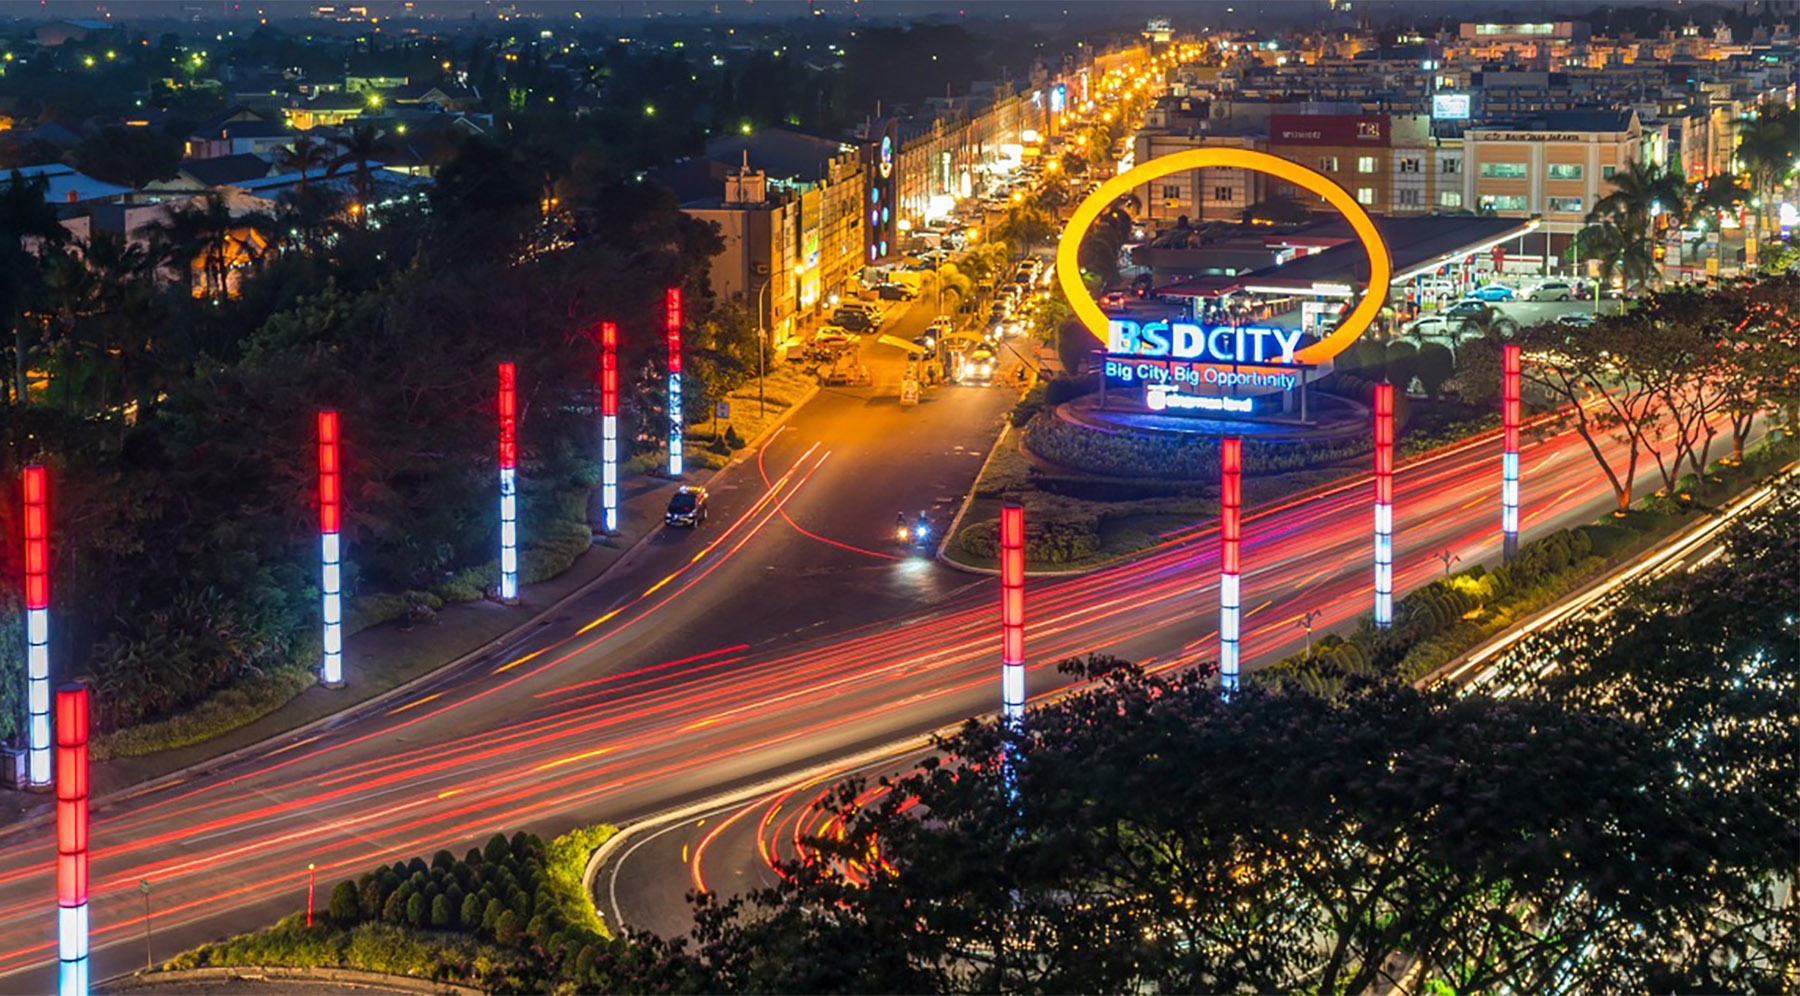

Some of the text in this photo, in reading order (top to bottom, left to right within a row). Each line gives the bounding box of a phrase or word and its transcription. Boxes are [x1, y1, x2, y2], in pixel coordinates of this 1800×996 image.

[1105, 361, 1133, 381] Big
[1174, 367, 1200, 386] Big
[1204, 367, 1296, 391] Opportunity
